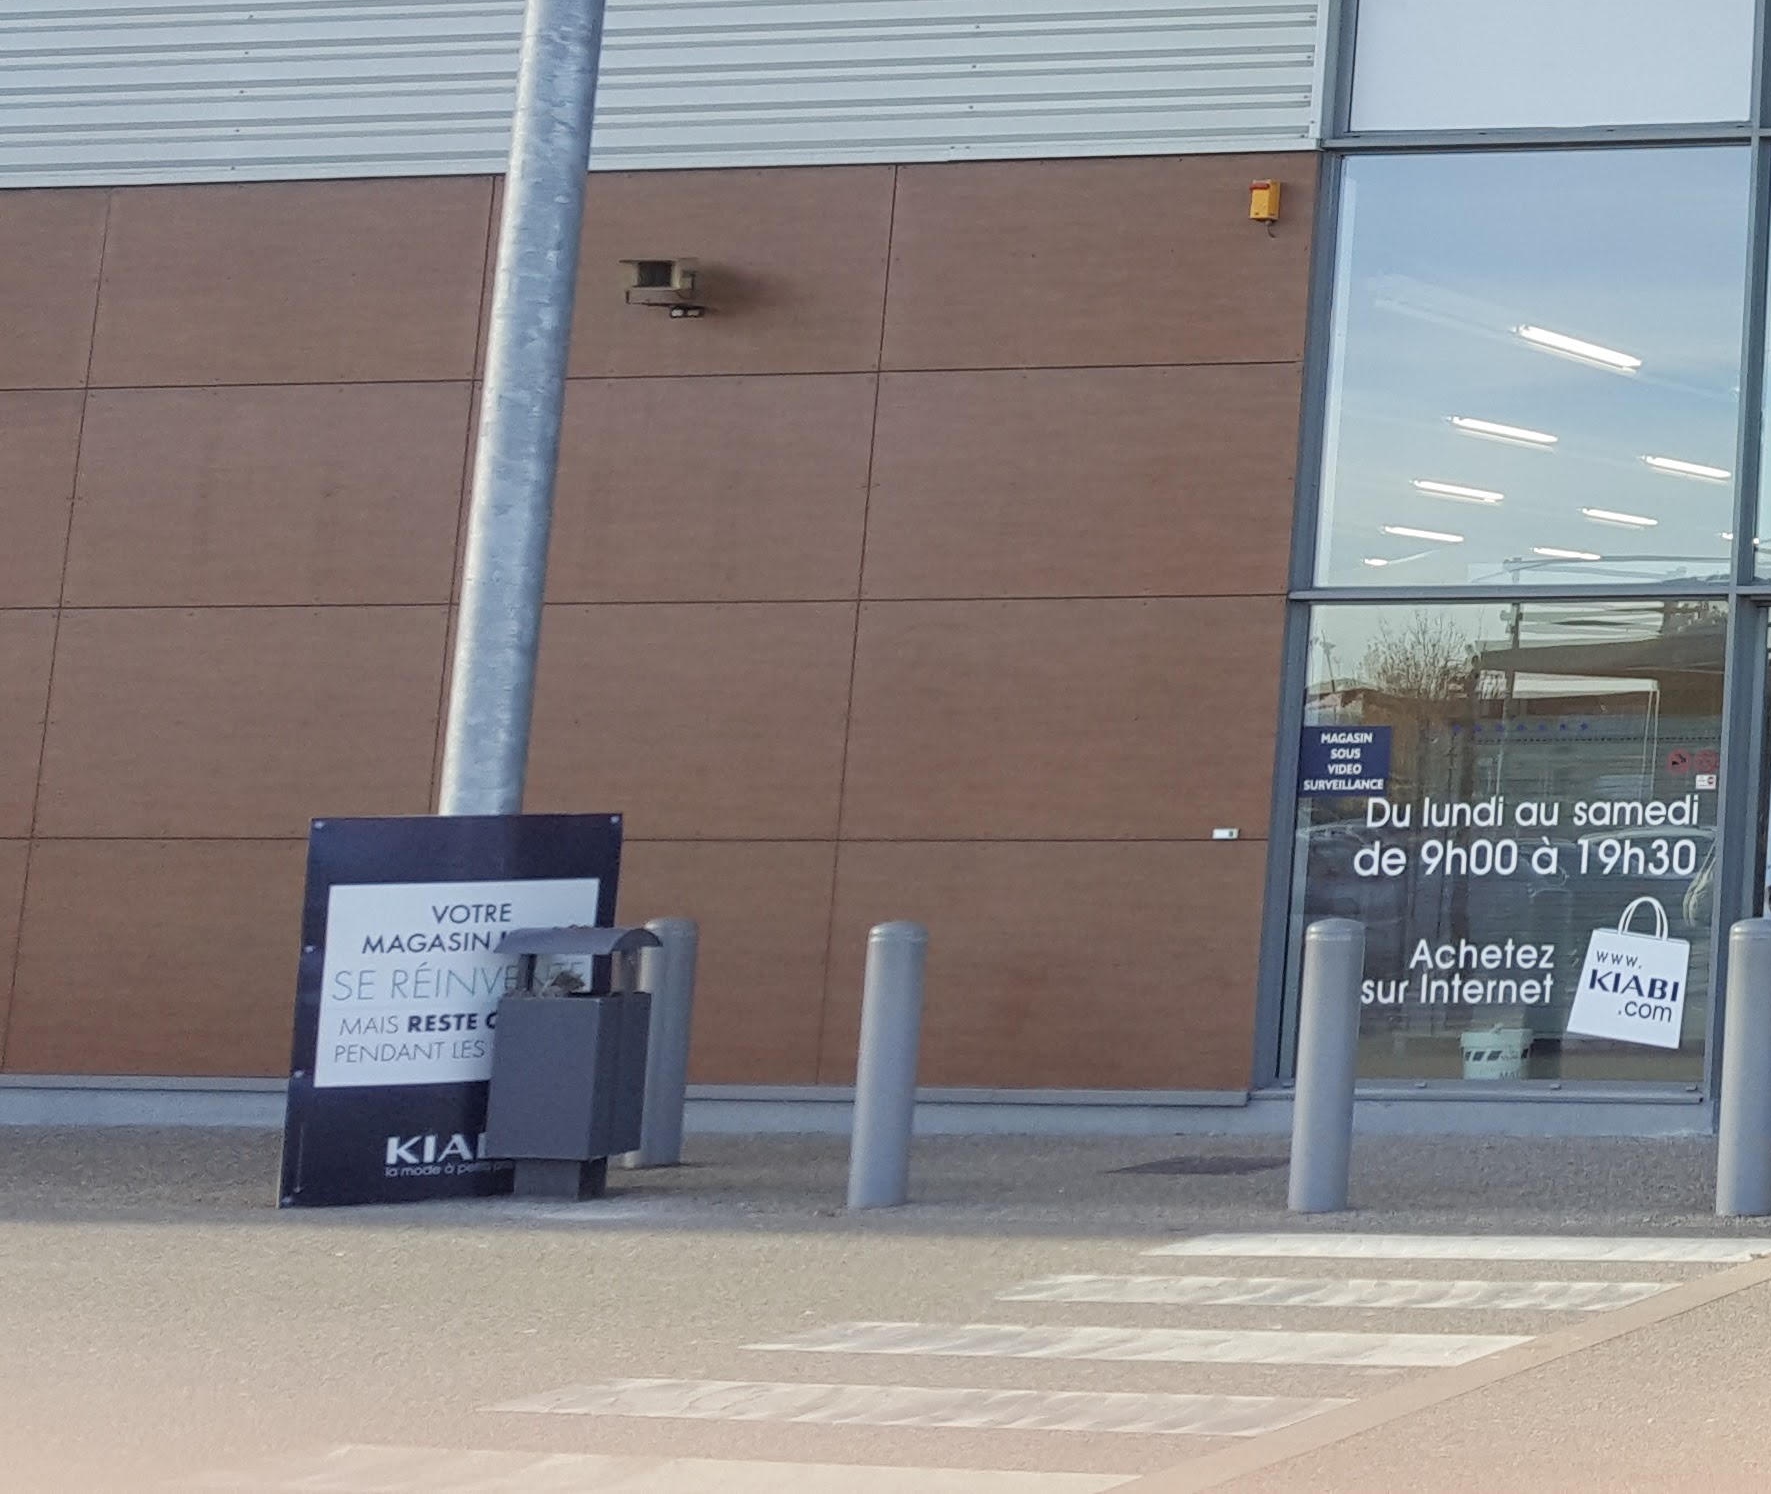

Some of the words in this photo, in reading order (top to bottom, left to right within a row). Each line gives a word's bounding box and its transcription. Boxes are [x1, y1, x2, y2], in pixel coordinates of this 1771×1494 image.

[1320, 732, 1373, 744] MAGASIN
[1330, 748, 1361, 760] SOUS
[1327, 763, 1362, 775] VIDEO
[1303, 778, 1385, 791] SURVEILLANCE
[1366, 796, 1411, 828] Du
[1422, 795, 1504, 828] lundi
[1515, 802, 1559, 827] au
[1573, 794, 1700, 826] samedi
[1353, 841, 1407, 877] de
[1420, 838, 1518, 877] 9h00
[1531, 835, 1558, 876] à
[1578, 838, 1697, 876] 19h30
[431, 903, 513, 924] VOTRE
[361, 931, 491, 954] MAGASIN
[1409, 938, 1555, 970] Achetez
[1596, 950, 1642, 970] www.
[331, 969, 376, 1002] SE
[1360, 978, 1408, 1005] sur
[1420, 974, 1554, 1005] Internet
[1589, 969, 1680, 1002] KIABI
[1617, 1000, 1673, 1023] .com
[338, 1015, 399, 1036] MAIS
[407, 1012, 478, 1033] RESTE
[334, 1041, 447, 1064] PENDANT
[452, 1039, 486, 1059] LES
[385, 1132, 487, 1165] KIA
[401, 1164, 441, 1177] mode
